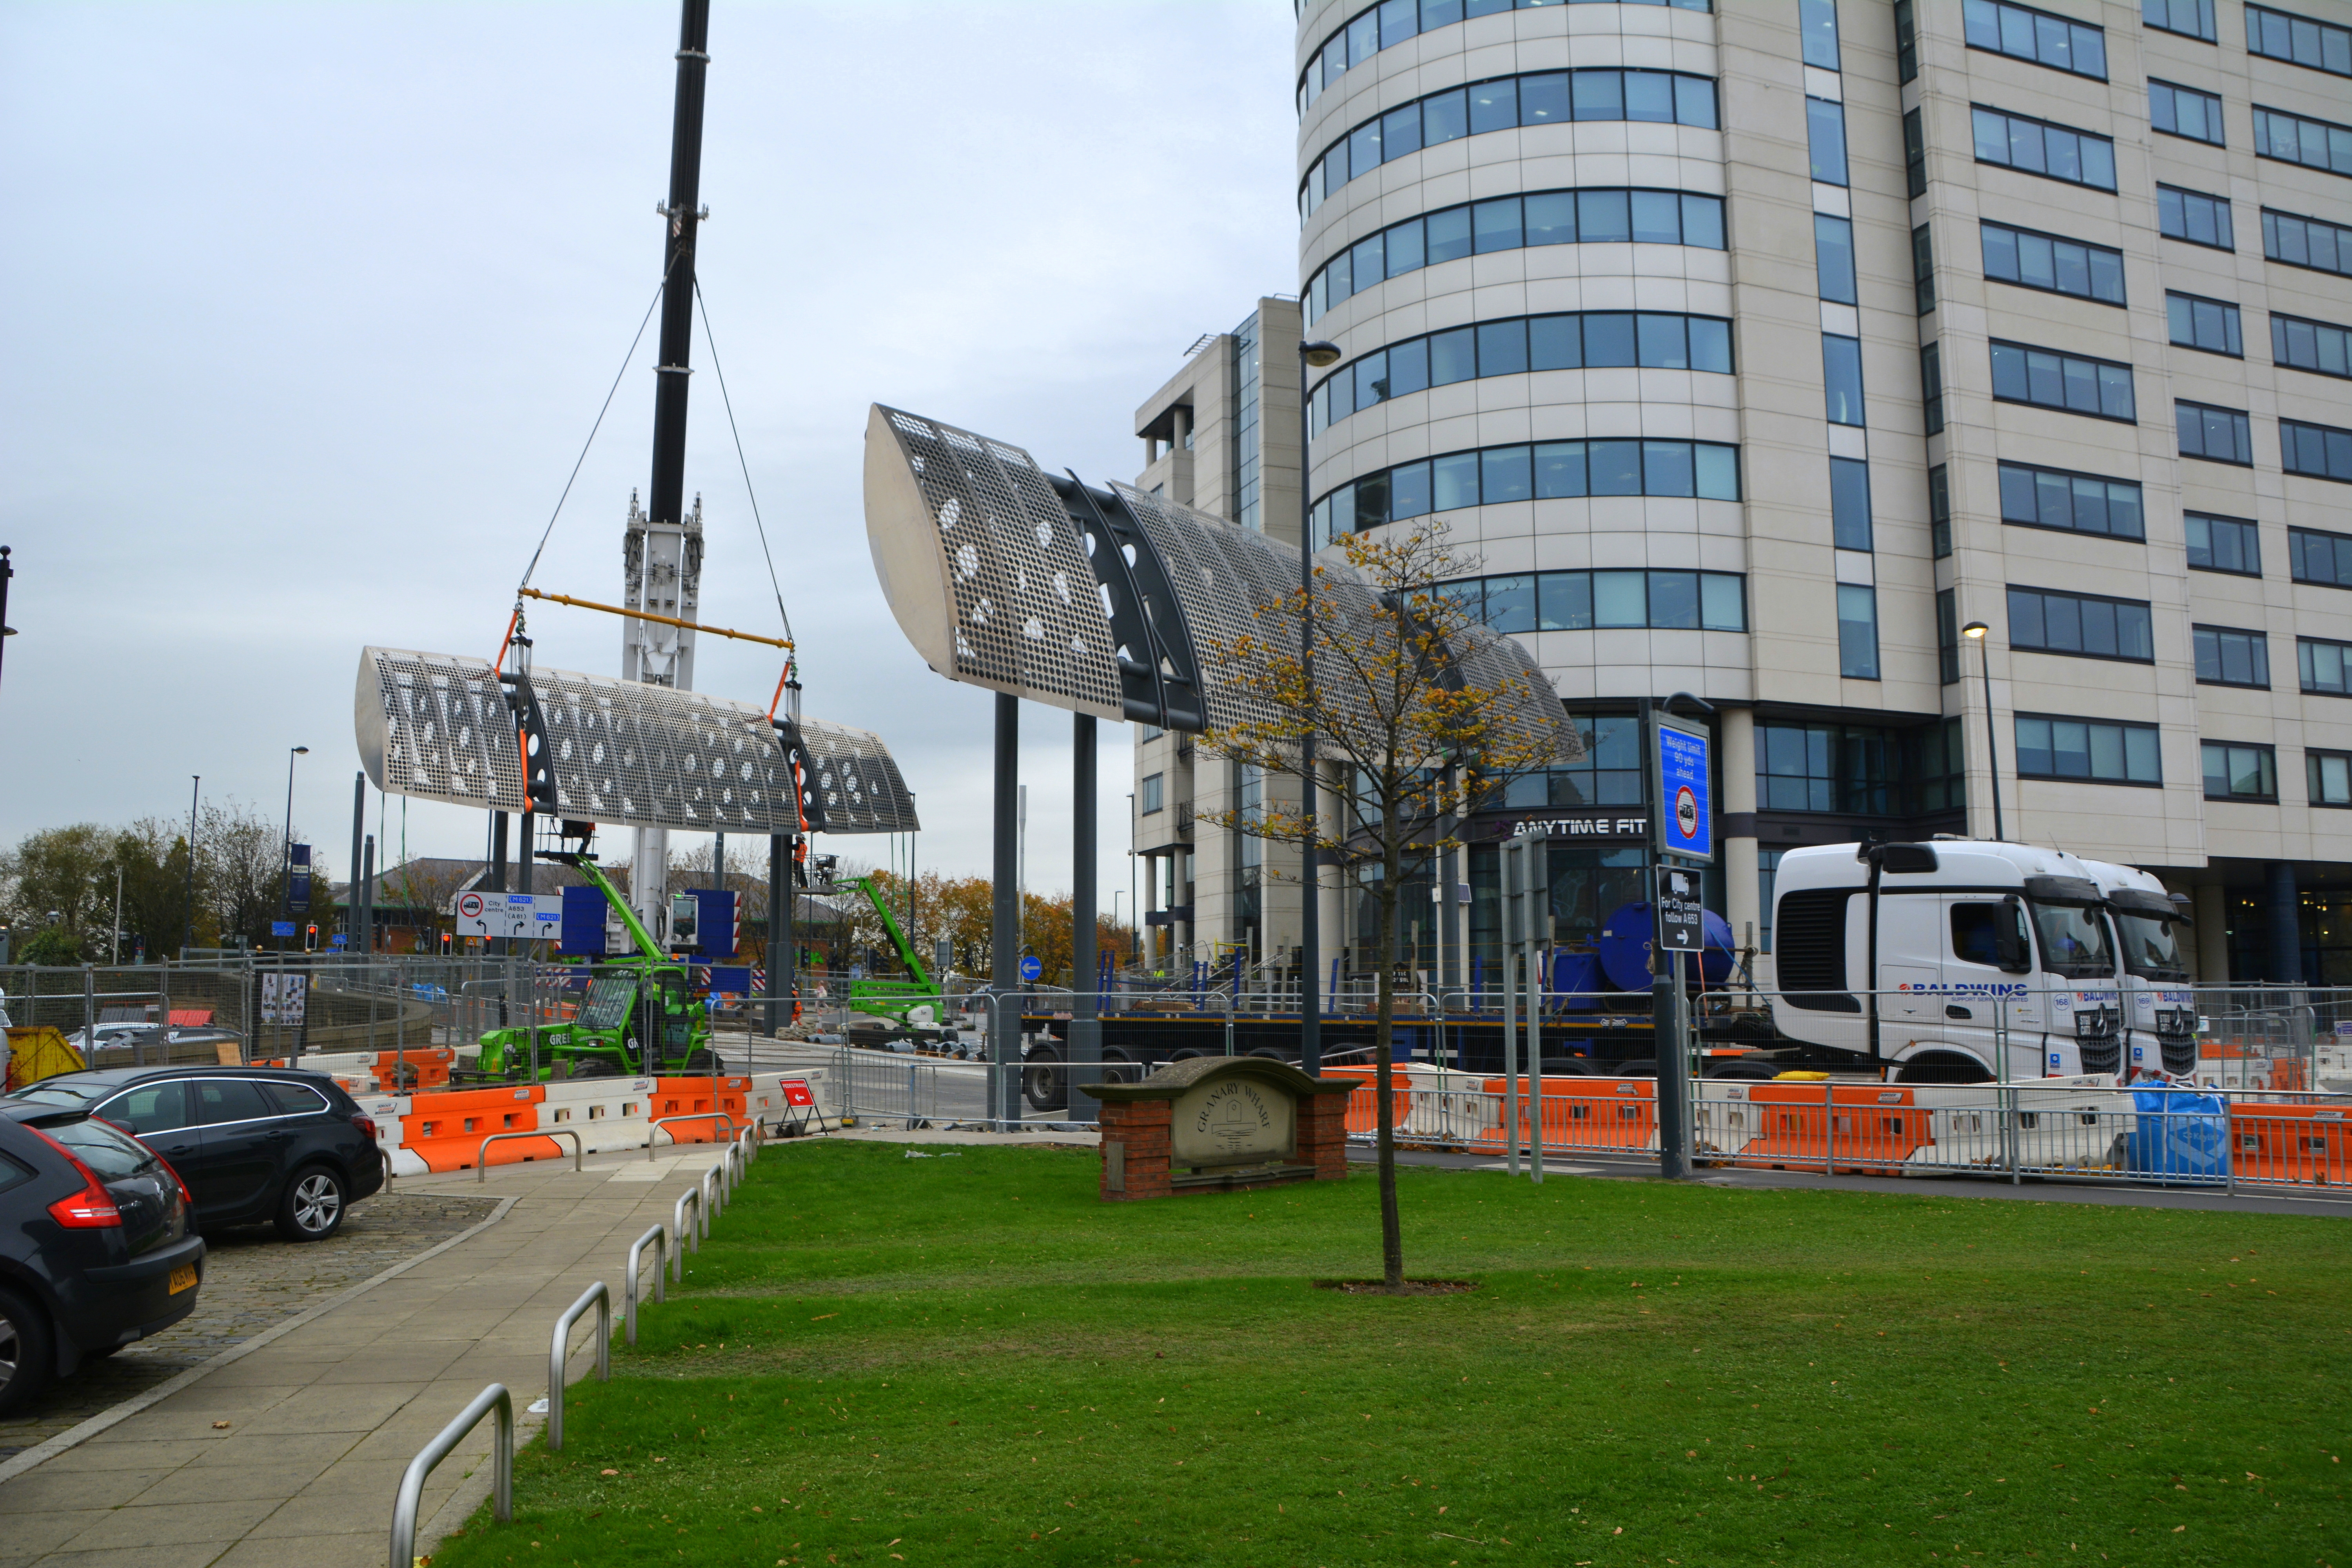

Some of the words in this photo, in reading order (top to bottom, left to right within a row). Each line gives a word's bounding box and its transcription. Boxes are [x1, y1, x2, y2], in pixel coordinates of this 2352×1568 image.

[1666, 735, 1686, 751] Weight
[1688, 742, 1700, 755] limit
[1674, 751, 1683, 763] 90
[1684, 756, 1694, 767] yds
[1676, 766, 1694, 780] ahead
[1514, 819, 1609, 836] ANYTIME
[1661, 897, 1670, 908] For
[1672, 898, 1683, 911] City
[1684, 900, 1700, 911] centre
[1665, 911, 1682, 923] follow
[1683, 913, 1698, 925] A653
[1913, 984, 2027, 996] BALDWINS
[2084, 992, 2117, 1002] BALDWINS
[2163, 992, 2192, 1003] BALDWINS
[1198, 1083, 1240, 1132] GRANARY
[1245, 1085, 1270, 1129] WHARF
